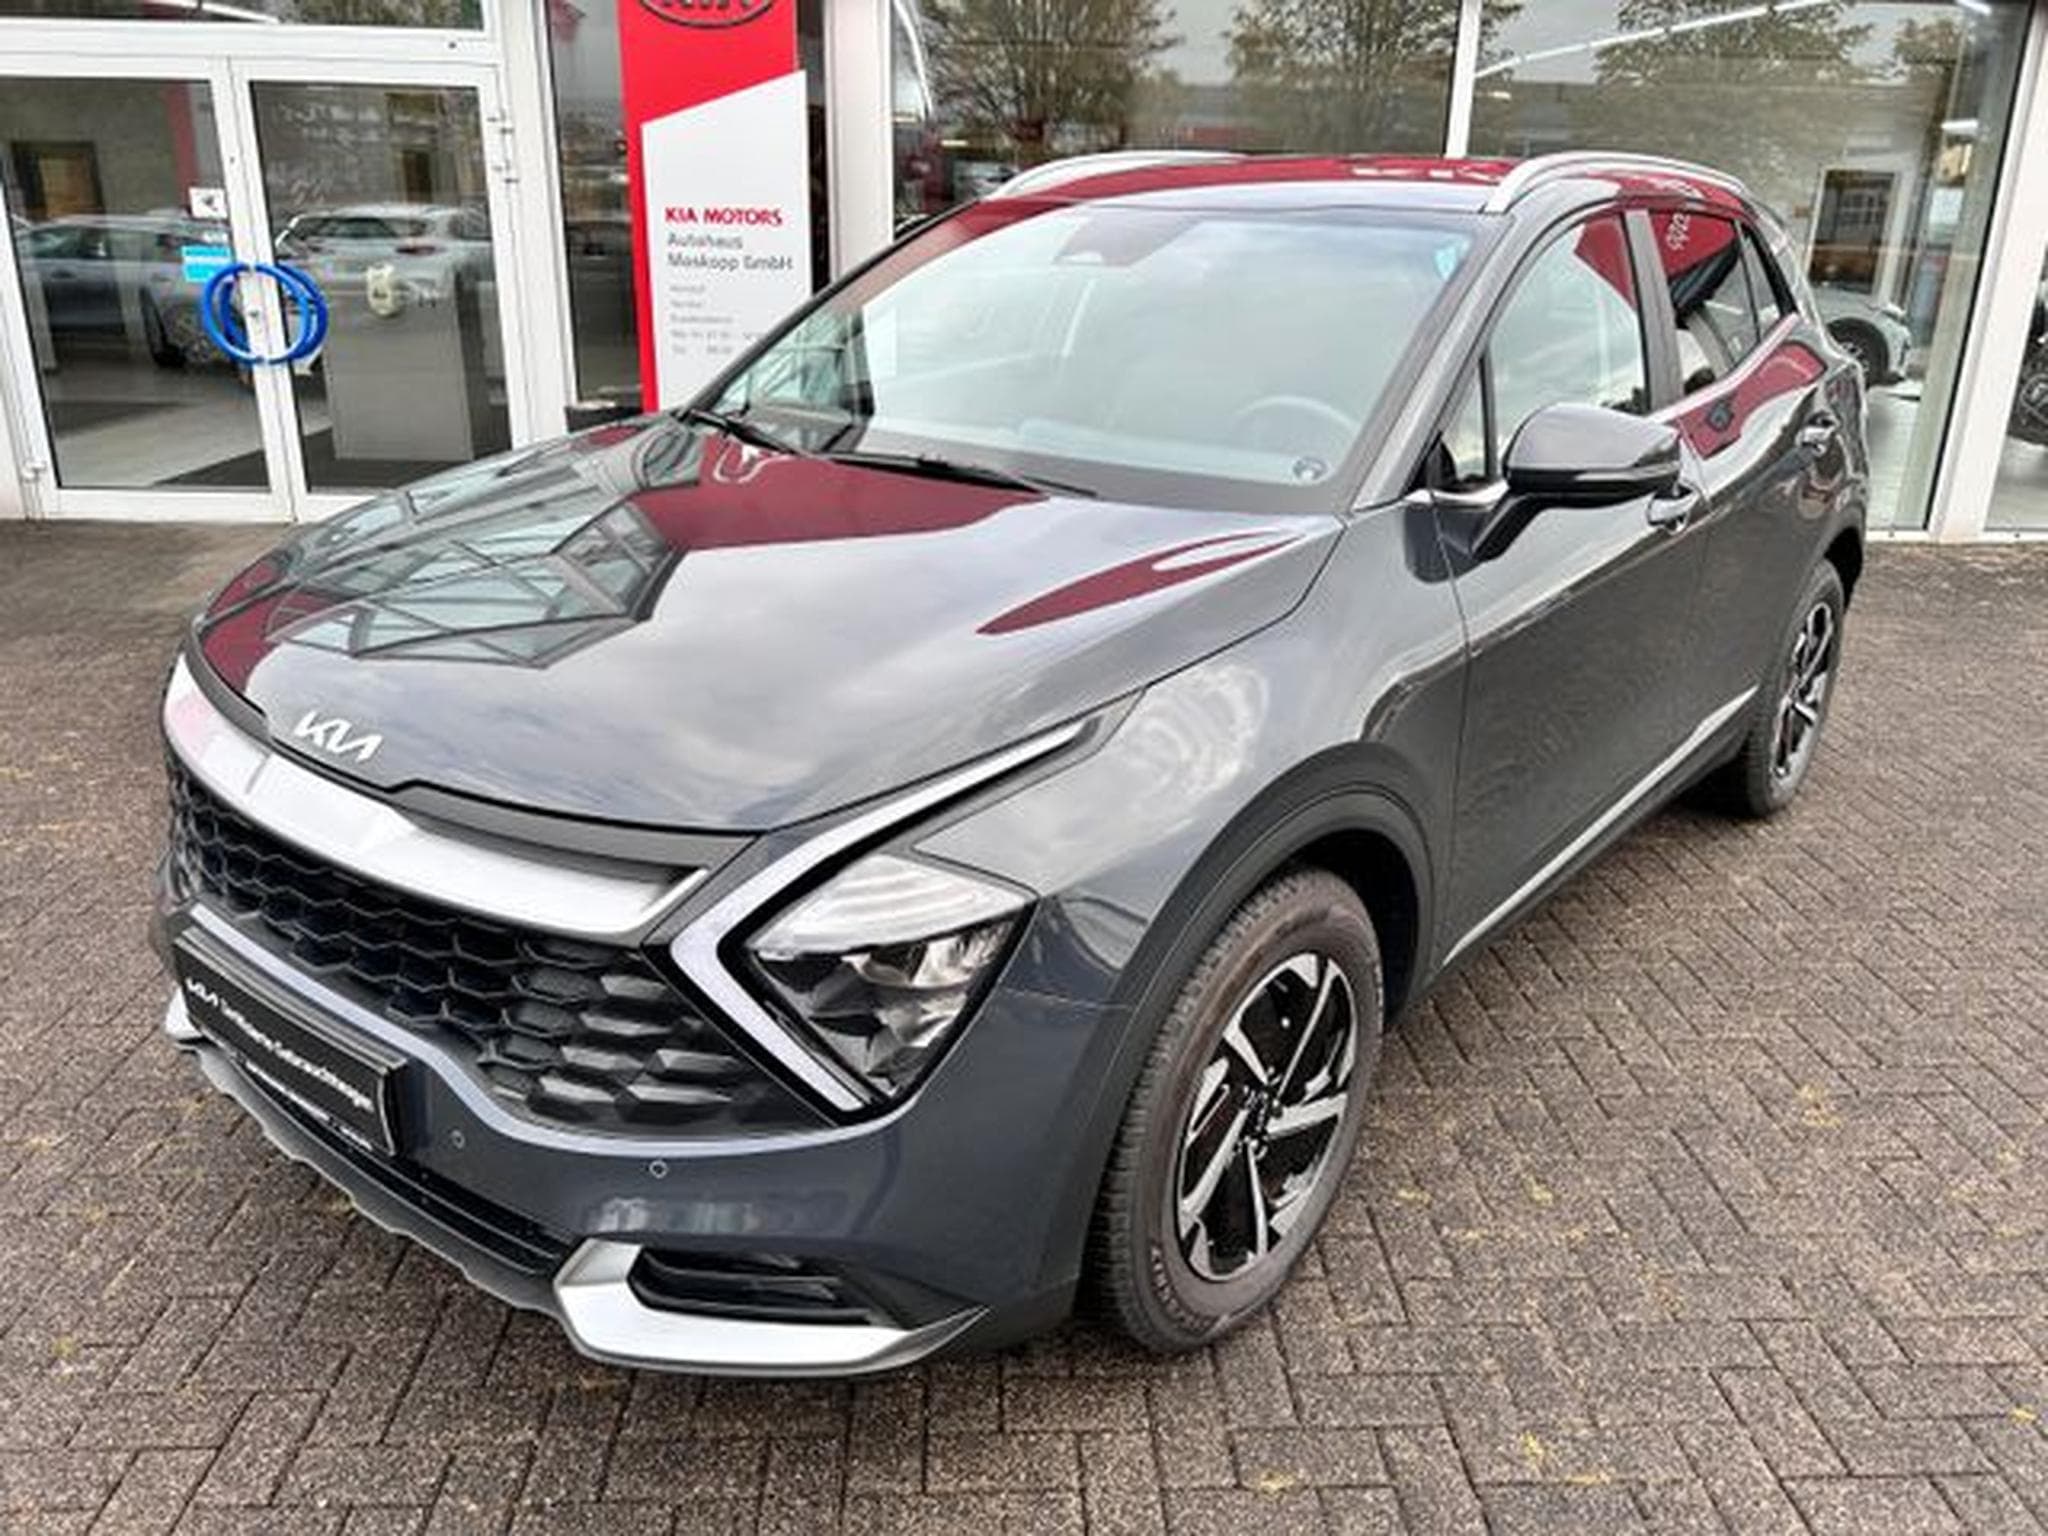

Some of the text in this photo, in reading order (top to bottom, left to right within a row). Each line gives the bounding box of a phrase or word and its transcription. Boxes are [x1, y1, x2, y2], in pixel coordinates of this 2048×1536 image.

[664, 206, 783, 226] KIA MOTORS
[667, 232, 743, 249] Autohaus
[743, 254, 793, 270] GmbH
[294, 710, 383, 763] KIA
